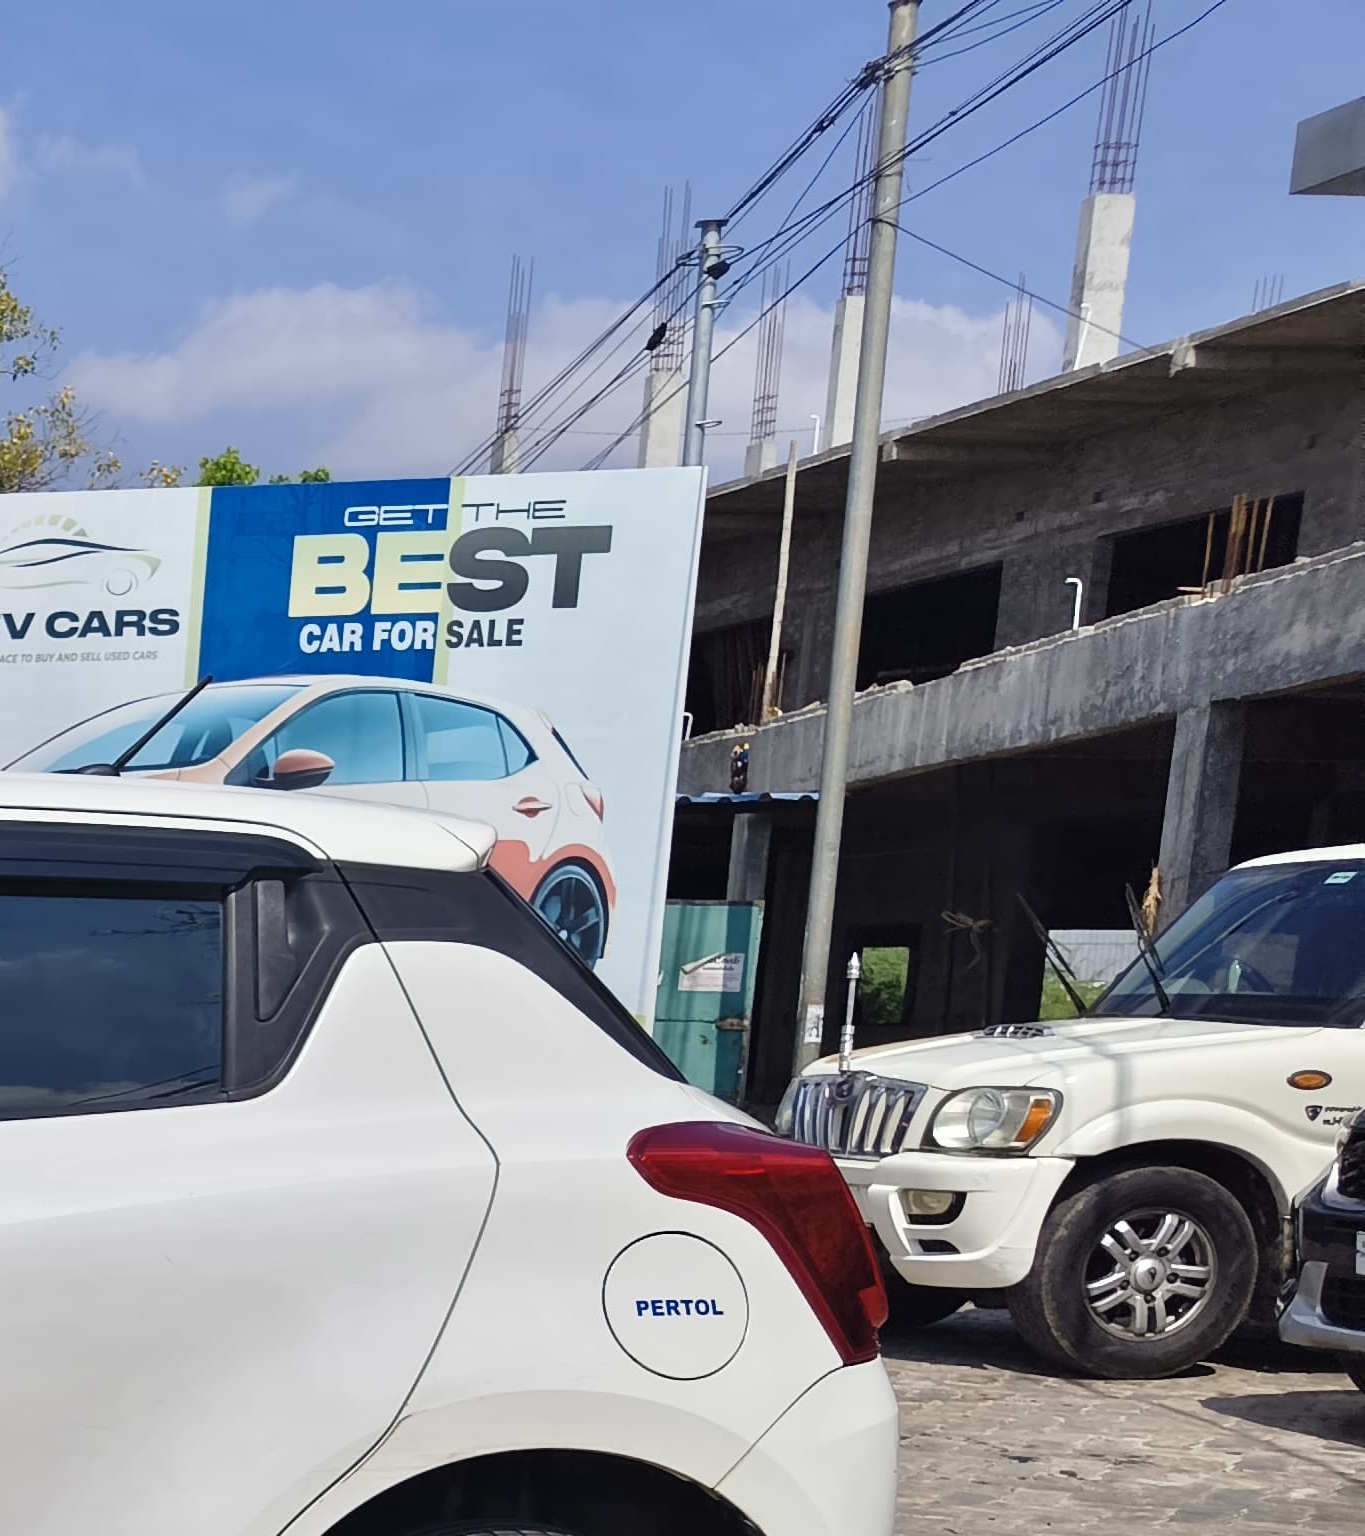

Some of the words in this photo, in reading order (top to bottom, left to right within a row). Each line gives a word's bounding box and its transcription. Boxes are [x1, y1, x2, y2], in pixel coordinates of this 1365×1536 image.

[344, 504, 449, 527] GET
[461, 500, 567, 521] THE
[288, 525, 613, 618] BEST
[45, 608, 181, 639] CARS
[299, 622, 363, 653] CAR
[372, 620, 435, 650] FOR
[445, 618, 525, 648] SALE
[20, 653, 33, 663] TO
[35, 652, 55, 663] BUY
[55, 652, 78, 662] AND
[80, 651, 102, 662] SELL
[104, 651, 130, 661] USED
[132, 650, 158, 661] CARS
[635, 1299, 724, 1316] PERTOL
